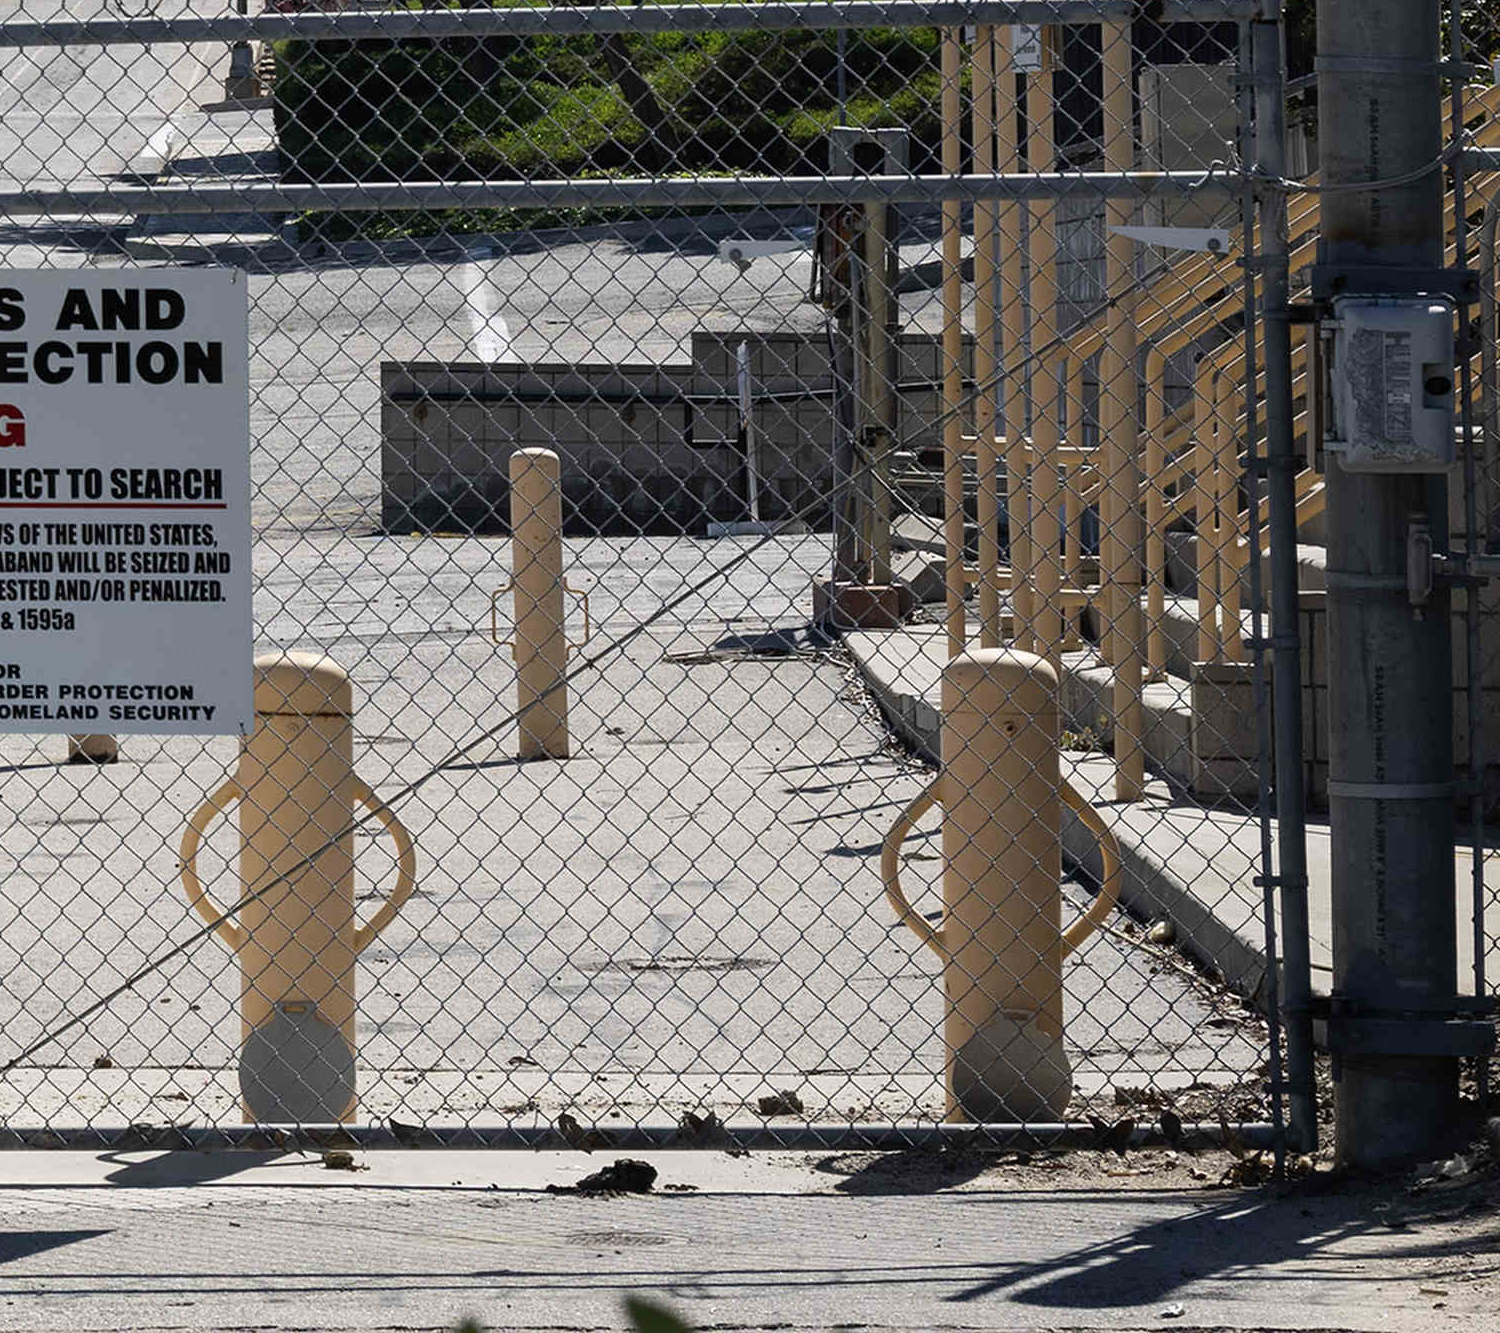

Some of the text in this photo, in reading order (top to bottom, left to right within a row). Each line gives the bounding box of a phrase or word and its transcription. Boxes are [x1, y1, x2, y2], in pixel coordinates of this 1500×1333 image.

[55, 288, 185, 330] AND
[66, 468, 102, 499] TO
[110, 468, 222, 500] SEARCH
[19, 523, 40, 545] OF
[43, 523, 77, 545] THE
[81, 523, 145, 545] UNITED
[149, 523, 217, 548] STATES,
[0, 611, 13, 630] &
[17, 608, 74, 630] 1595a
[59, 684, 193, 700] PROTECTION
[109, 705, 215, 721] SECURITY
